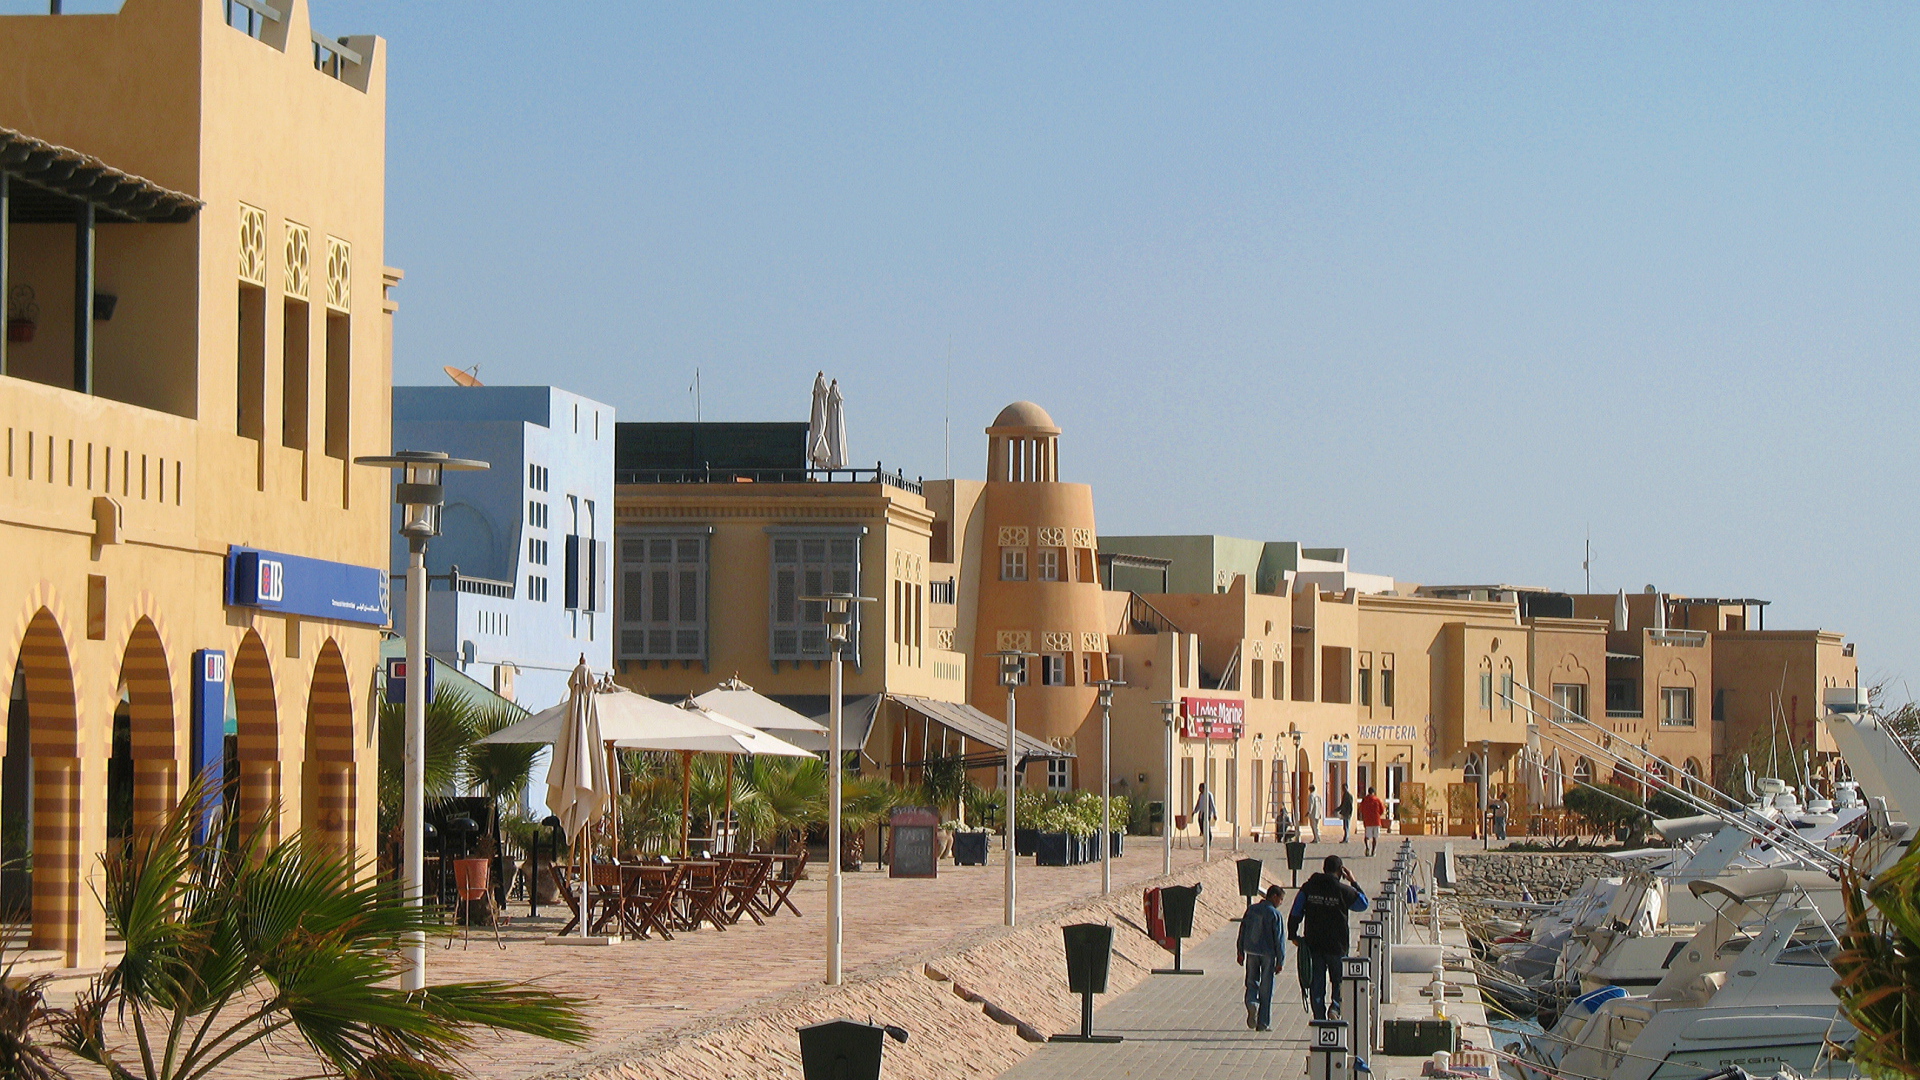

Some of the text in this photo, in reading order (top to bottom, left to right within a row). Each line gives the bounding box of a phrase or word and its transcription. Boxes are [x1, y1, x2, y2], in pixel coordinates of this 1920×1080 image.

[258, 559, 283, 602] CIB
[1195, 701, 1243, 724] Lodos Marine
[1351, 964, 1360, 973] 18
[1322, 1031, 1336, 1042] 20
[1719, 1056, 1789, 1066] REGAL
